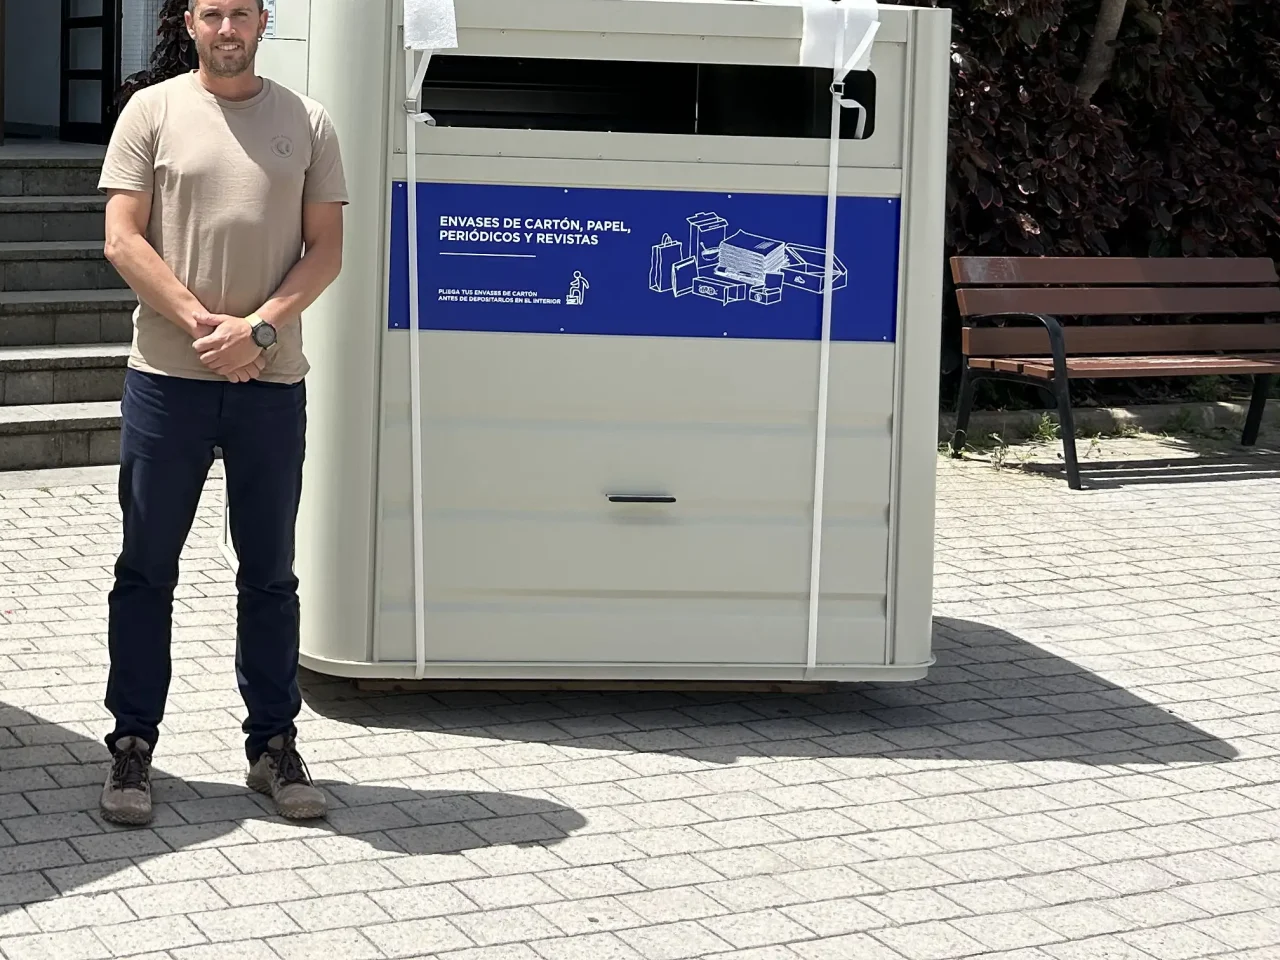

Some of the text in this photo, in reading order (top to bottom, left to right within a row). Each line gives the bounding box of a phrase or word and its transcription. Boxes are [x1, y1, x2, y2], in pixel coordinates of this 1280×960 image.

[440, 216, 631, 234] ENVASES DE CARTÓN, PAPEL,
[440, 229, 599, 245] PERIÓDICOS Y REVISTAS
